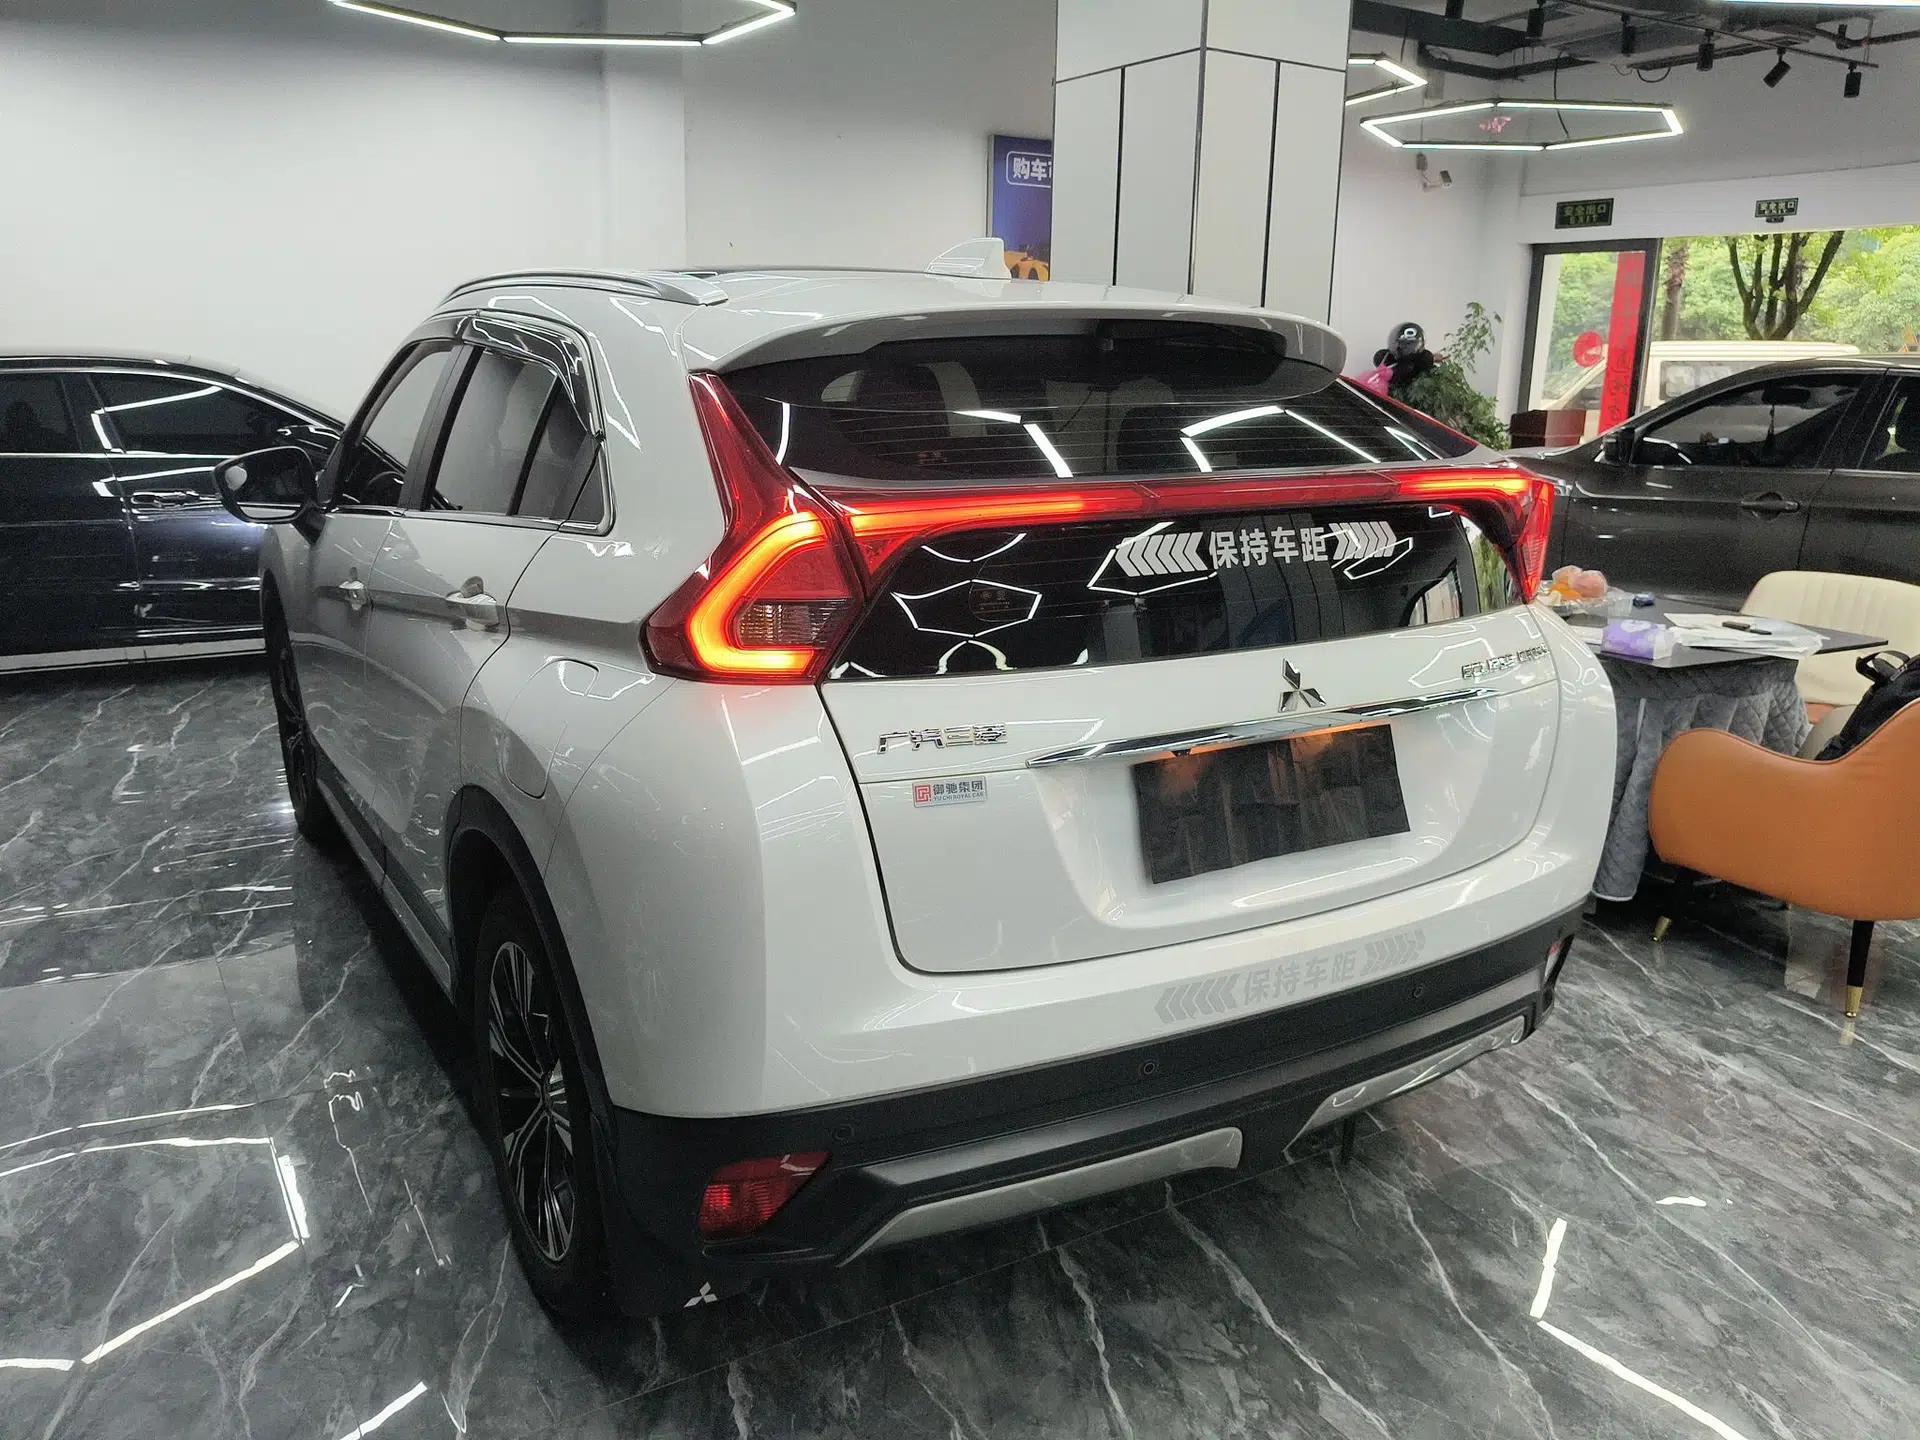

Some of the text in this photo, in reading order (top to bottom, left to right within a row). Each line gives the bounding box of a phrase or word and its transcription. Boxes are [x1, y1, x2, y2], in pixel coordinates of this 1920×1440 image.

[1013, 157, 1051, 181] 购车
[1209, 526, 1328, 569] 保持车距
[877, 724, 1007, 755] 广汽三菱
[933, 780, 983, 795] 御驰集团
[1244, 951, 1356, 1006] 保持车距
